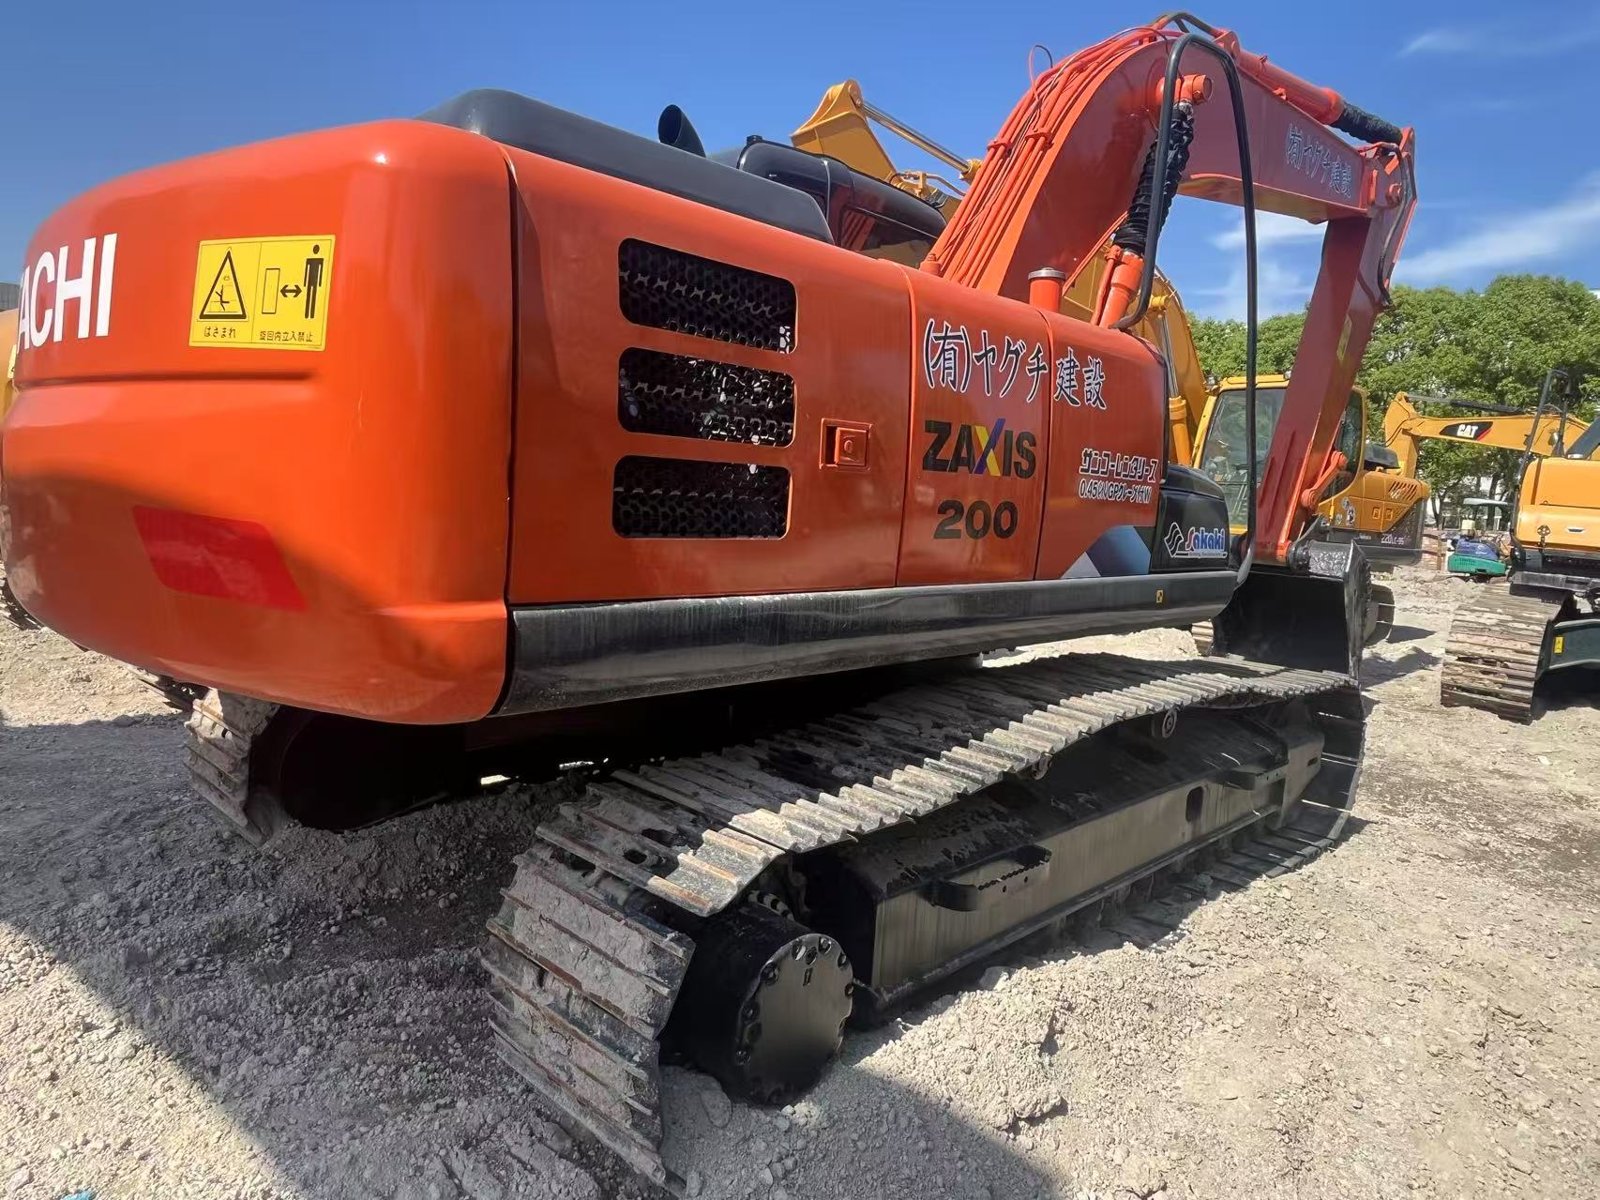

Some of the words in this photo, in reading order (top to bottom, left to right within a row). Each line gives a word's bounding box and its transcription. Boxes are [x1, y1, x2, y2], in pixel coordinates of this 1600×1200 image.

[204, 326, 236, 339] はさまれ
[1457, 424, 1479, 438] CAT
[922, 418, 1037, 480] ZAXIS
[933, 499, 1019, 540] 200
[1185, 526, 1226, 552] Sakaki
